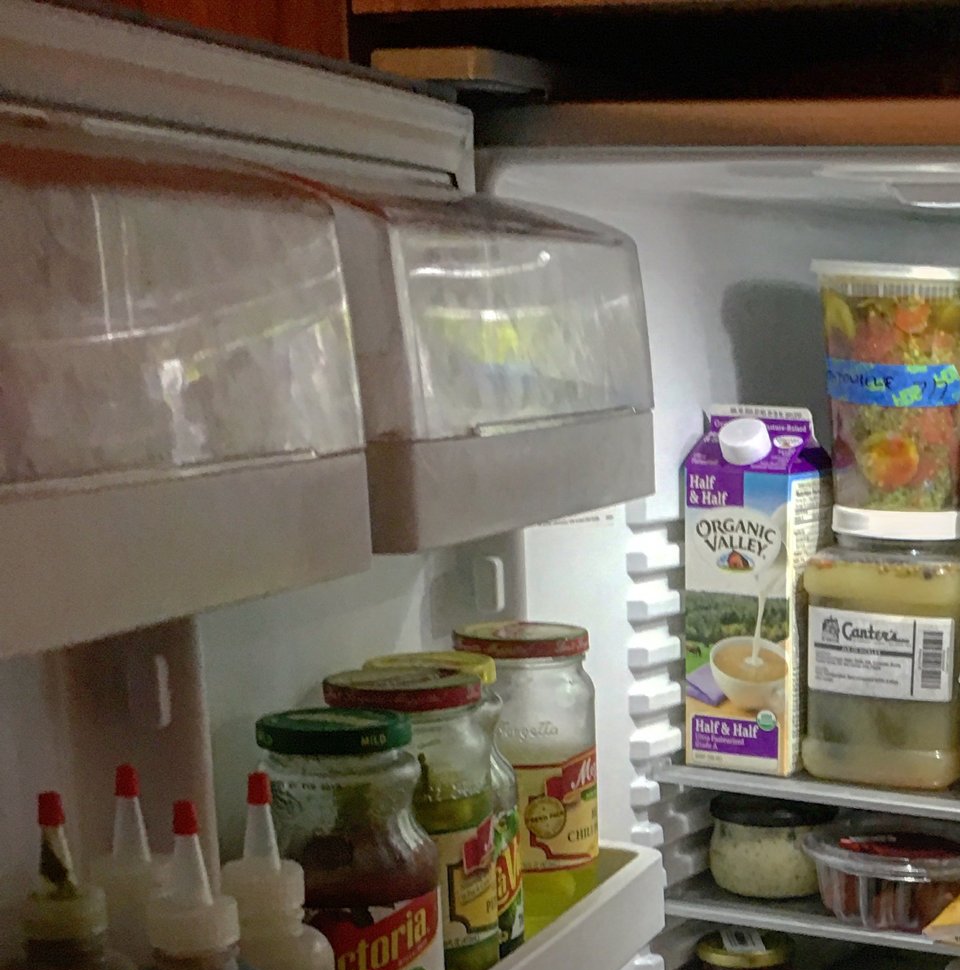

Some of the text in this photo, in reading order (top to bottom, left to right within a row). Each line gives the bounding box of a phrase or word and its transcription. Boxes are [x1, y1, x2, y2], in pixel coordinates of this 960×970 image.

[689, 474, 716, 490] Half
[689, 491, 728, 506] & Half
[696, 519, 777, 545] ORGANIC
[704, 535, 767, 558] VALLEY
[842, 621, 905, 643] Canter's
[695, 719, 760, 739] Half & Half
[361, 733, 387, 747] MILD
